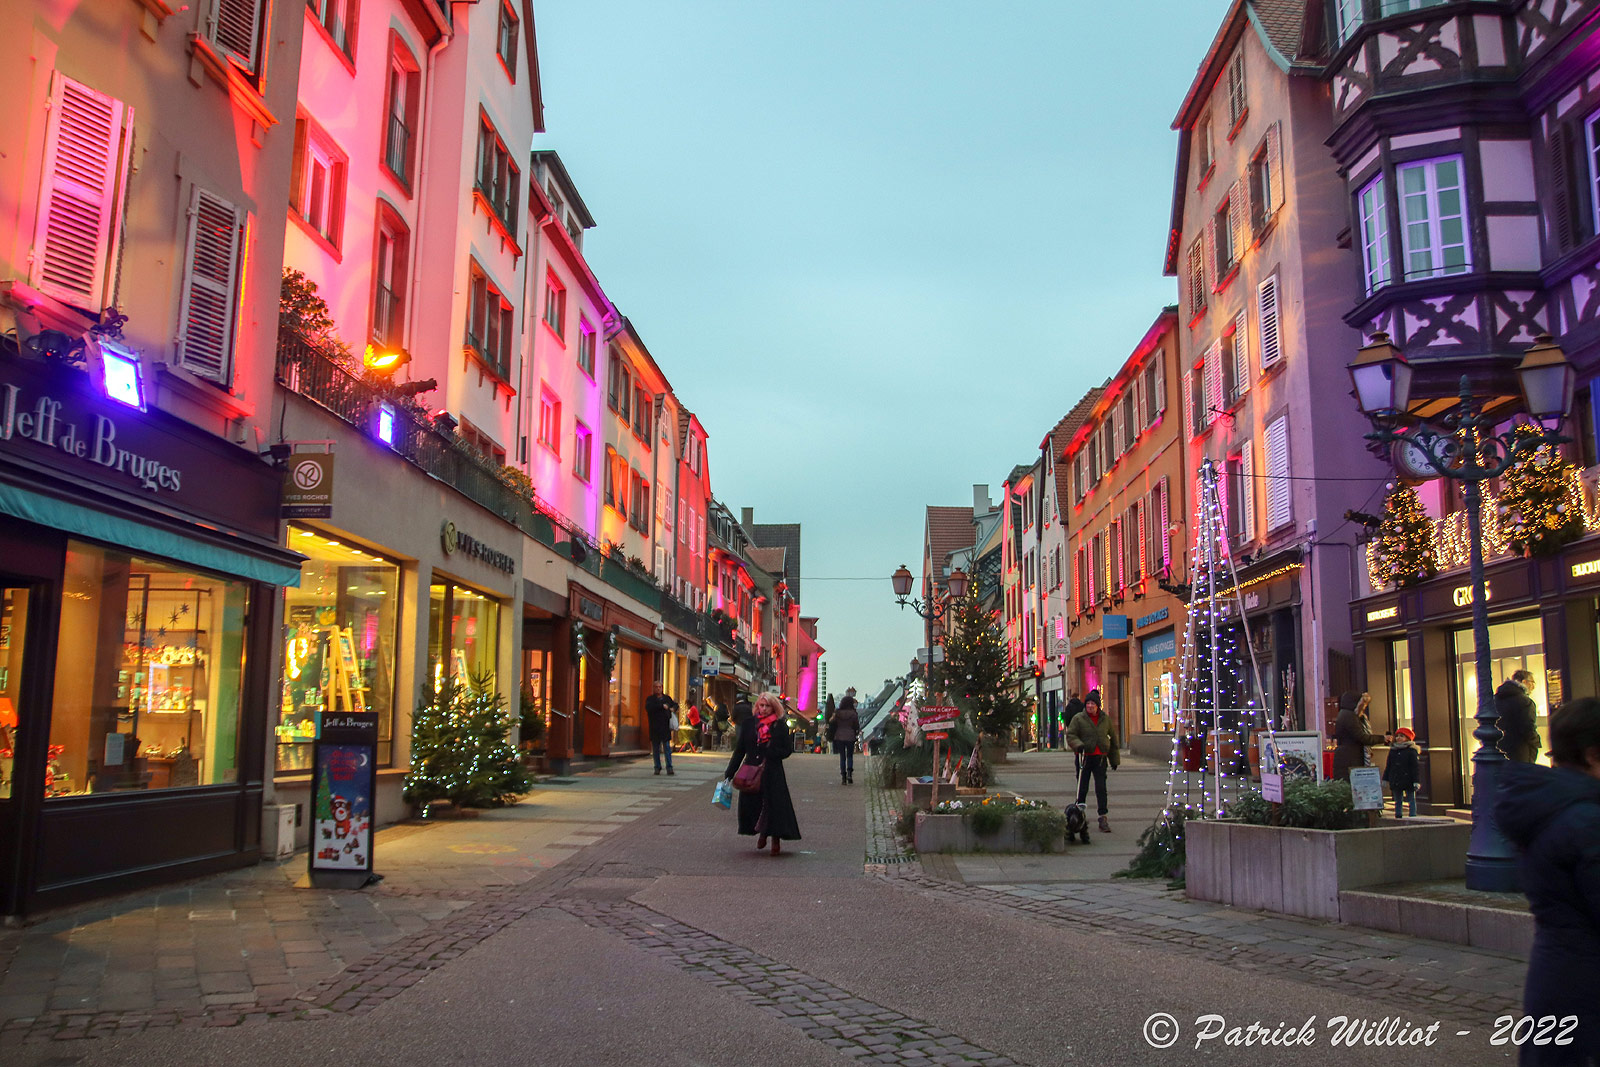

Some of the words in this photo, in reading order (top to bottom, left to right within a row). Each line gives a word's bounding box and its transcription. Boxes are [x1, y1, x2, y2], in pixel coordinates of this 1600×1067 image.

[0, 382, 62, 448] Jeff
[60, 423, 87, 458] de
[89, 414, 182, 492] Bruges
[480, 543, 515, 575] ROCHER
[346, 716, 374, 729] Bruges
